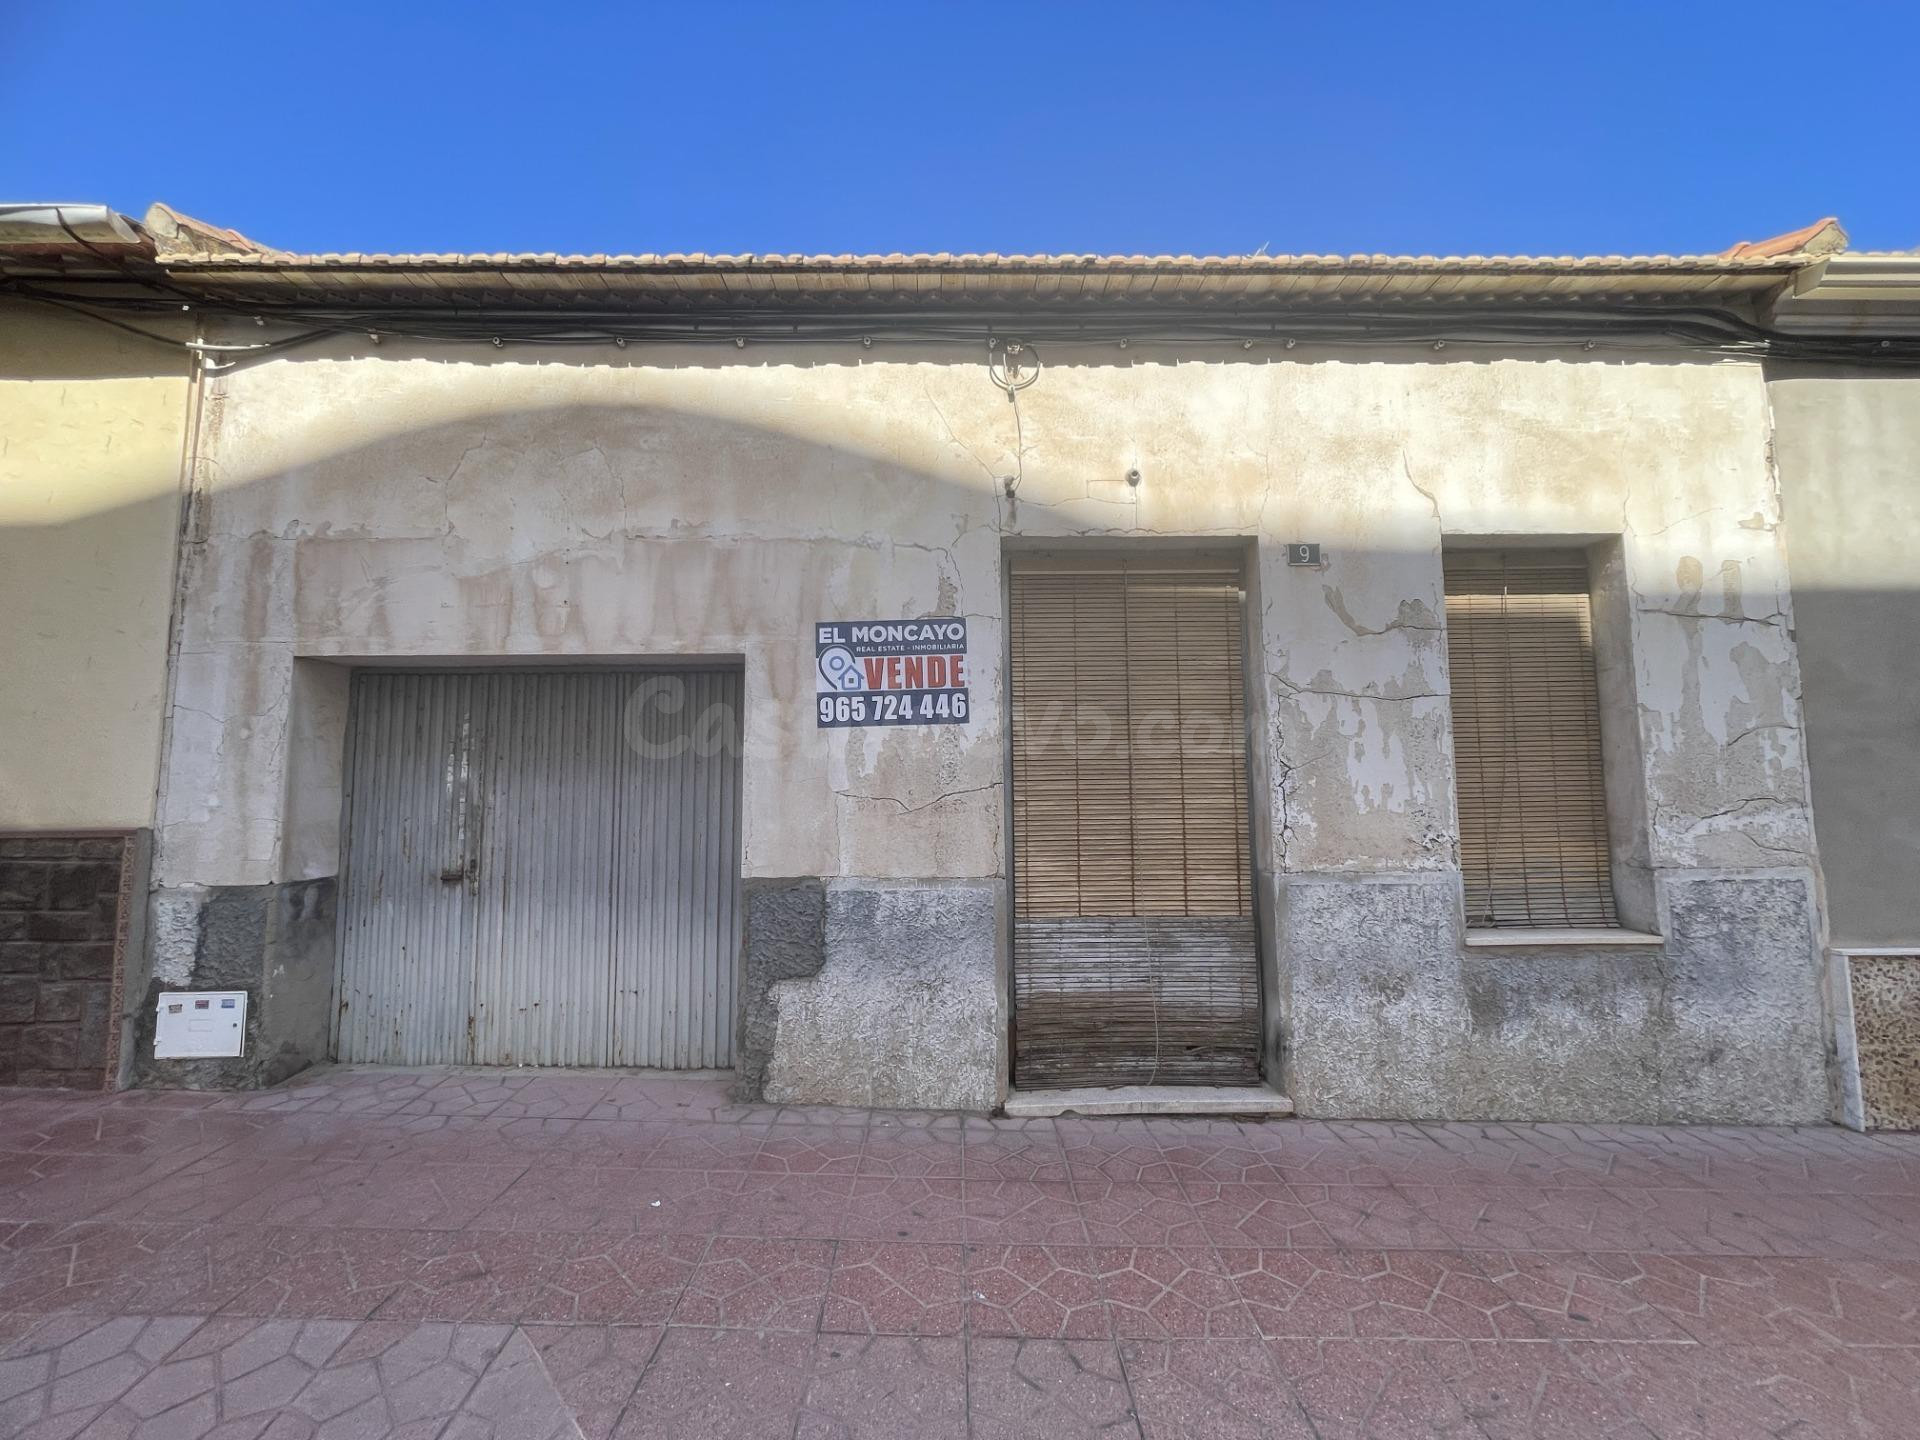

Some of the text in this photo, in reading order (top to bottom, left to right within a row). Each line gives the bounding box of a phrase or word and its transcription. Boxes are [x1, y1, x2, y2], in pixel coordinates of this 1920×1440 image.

[1299, 545, 1310, 563] 9
[818, 623, 965, 644] EL MONCAYO
[856, 645, 876, 653] REAL
[912, 643, 965, 651] INMOBILIARIA
[863, 655, 966, 690] VENDE
[819, 692, 967, 723] 965 724 446
